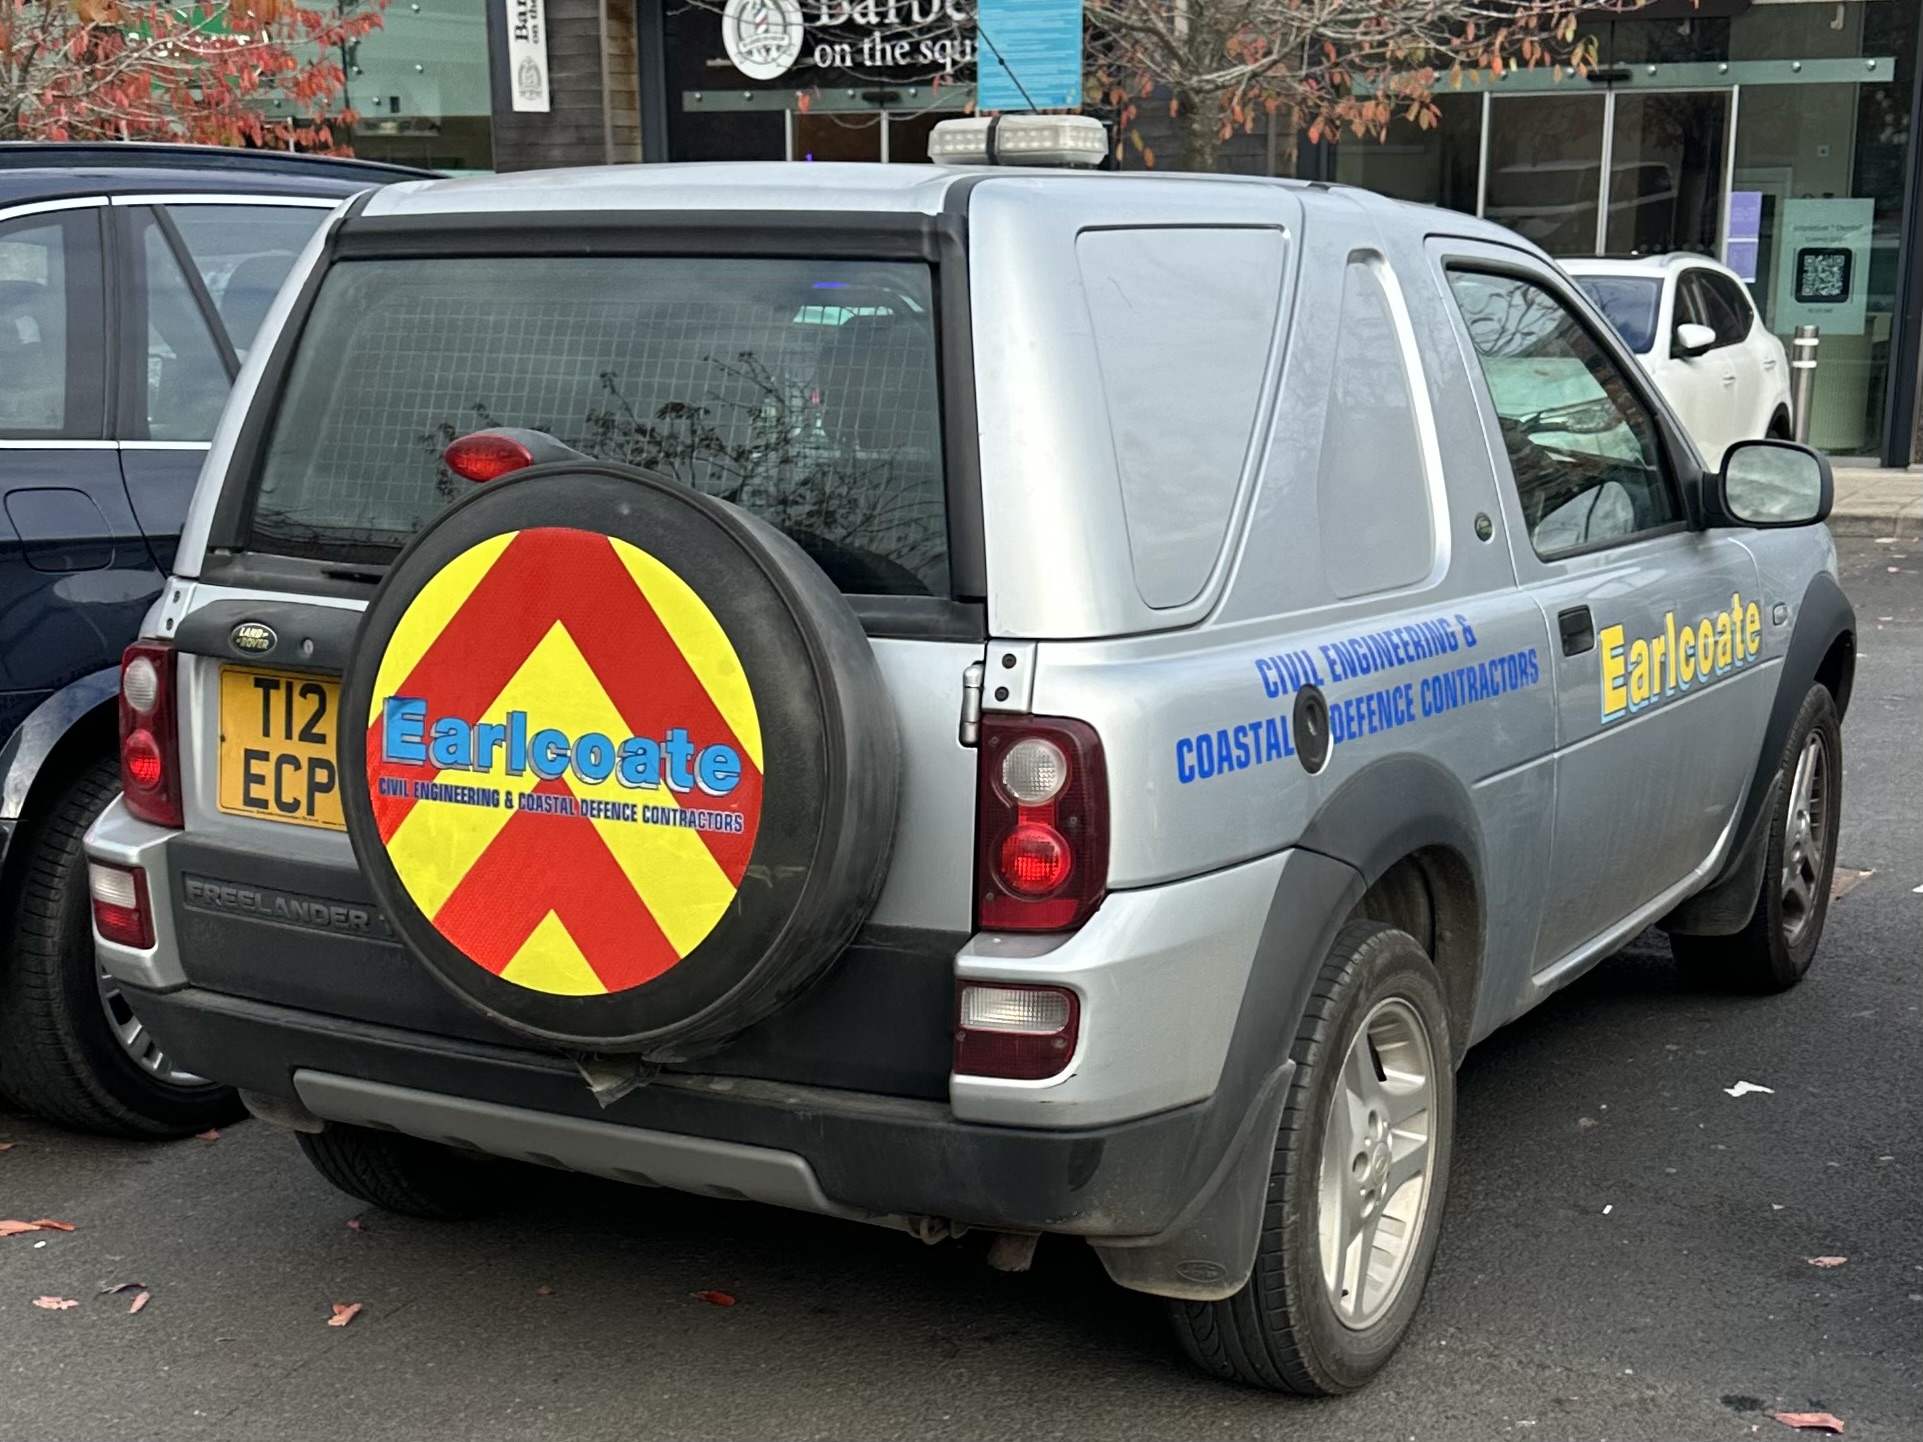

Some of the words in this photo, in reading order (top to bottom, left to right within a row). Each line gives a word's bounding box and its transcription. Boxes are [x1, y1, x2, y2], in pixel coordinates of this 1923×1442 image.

[815, 0, 978, 26] Barbe
[813, 42, 854, 68] on
[862, 31, 911, 67] the
[918, 39, 978, 74] squ
[1255, 649, 1325, 699] CIVIL
[1319, 617, 1459, 683] ENGINEERING
[1455, 613, 1478, 648] &
[1599, 591, 1761, 725] Earlcoate
[382, 696, 742, 797] Earlcoate
[1176, 714, 1296, 784] COASTAL
[1328, 682, 1416, 745] DEFENCE
[1420, 648, 1540, 718] CONTRACTORS
[242, 748, 336, 817] ECP
[378, 777, 410, 797] CIVIL
[414, 780, 501, 808] ENGINEERING
[504, 790, 514, 809] &
[518, 792, 576, 816] COASTAL
[580, 797, 638, 822] DEFENCE
[642, 805, 744, 833] CONTRACTORS
[186, 879, 371, 932] FREELANDER
